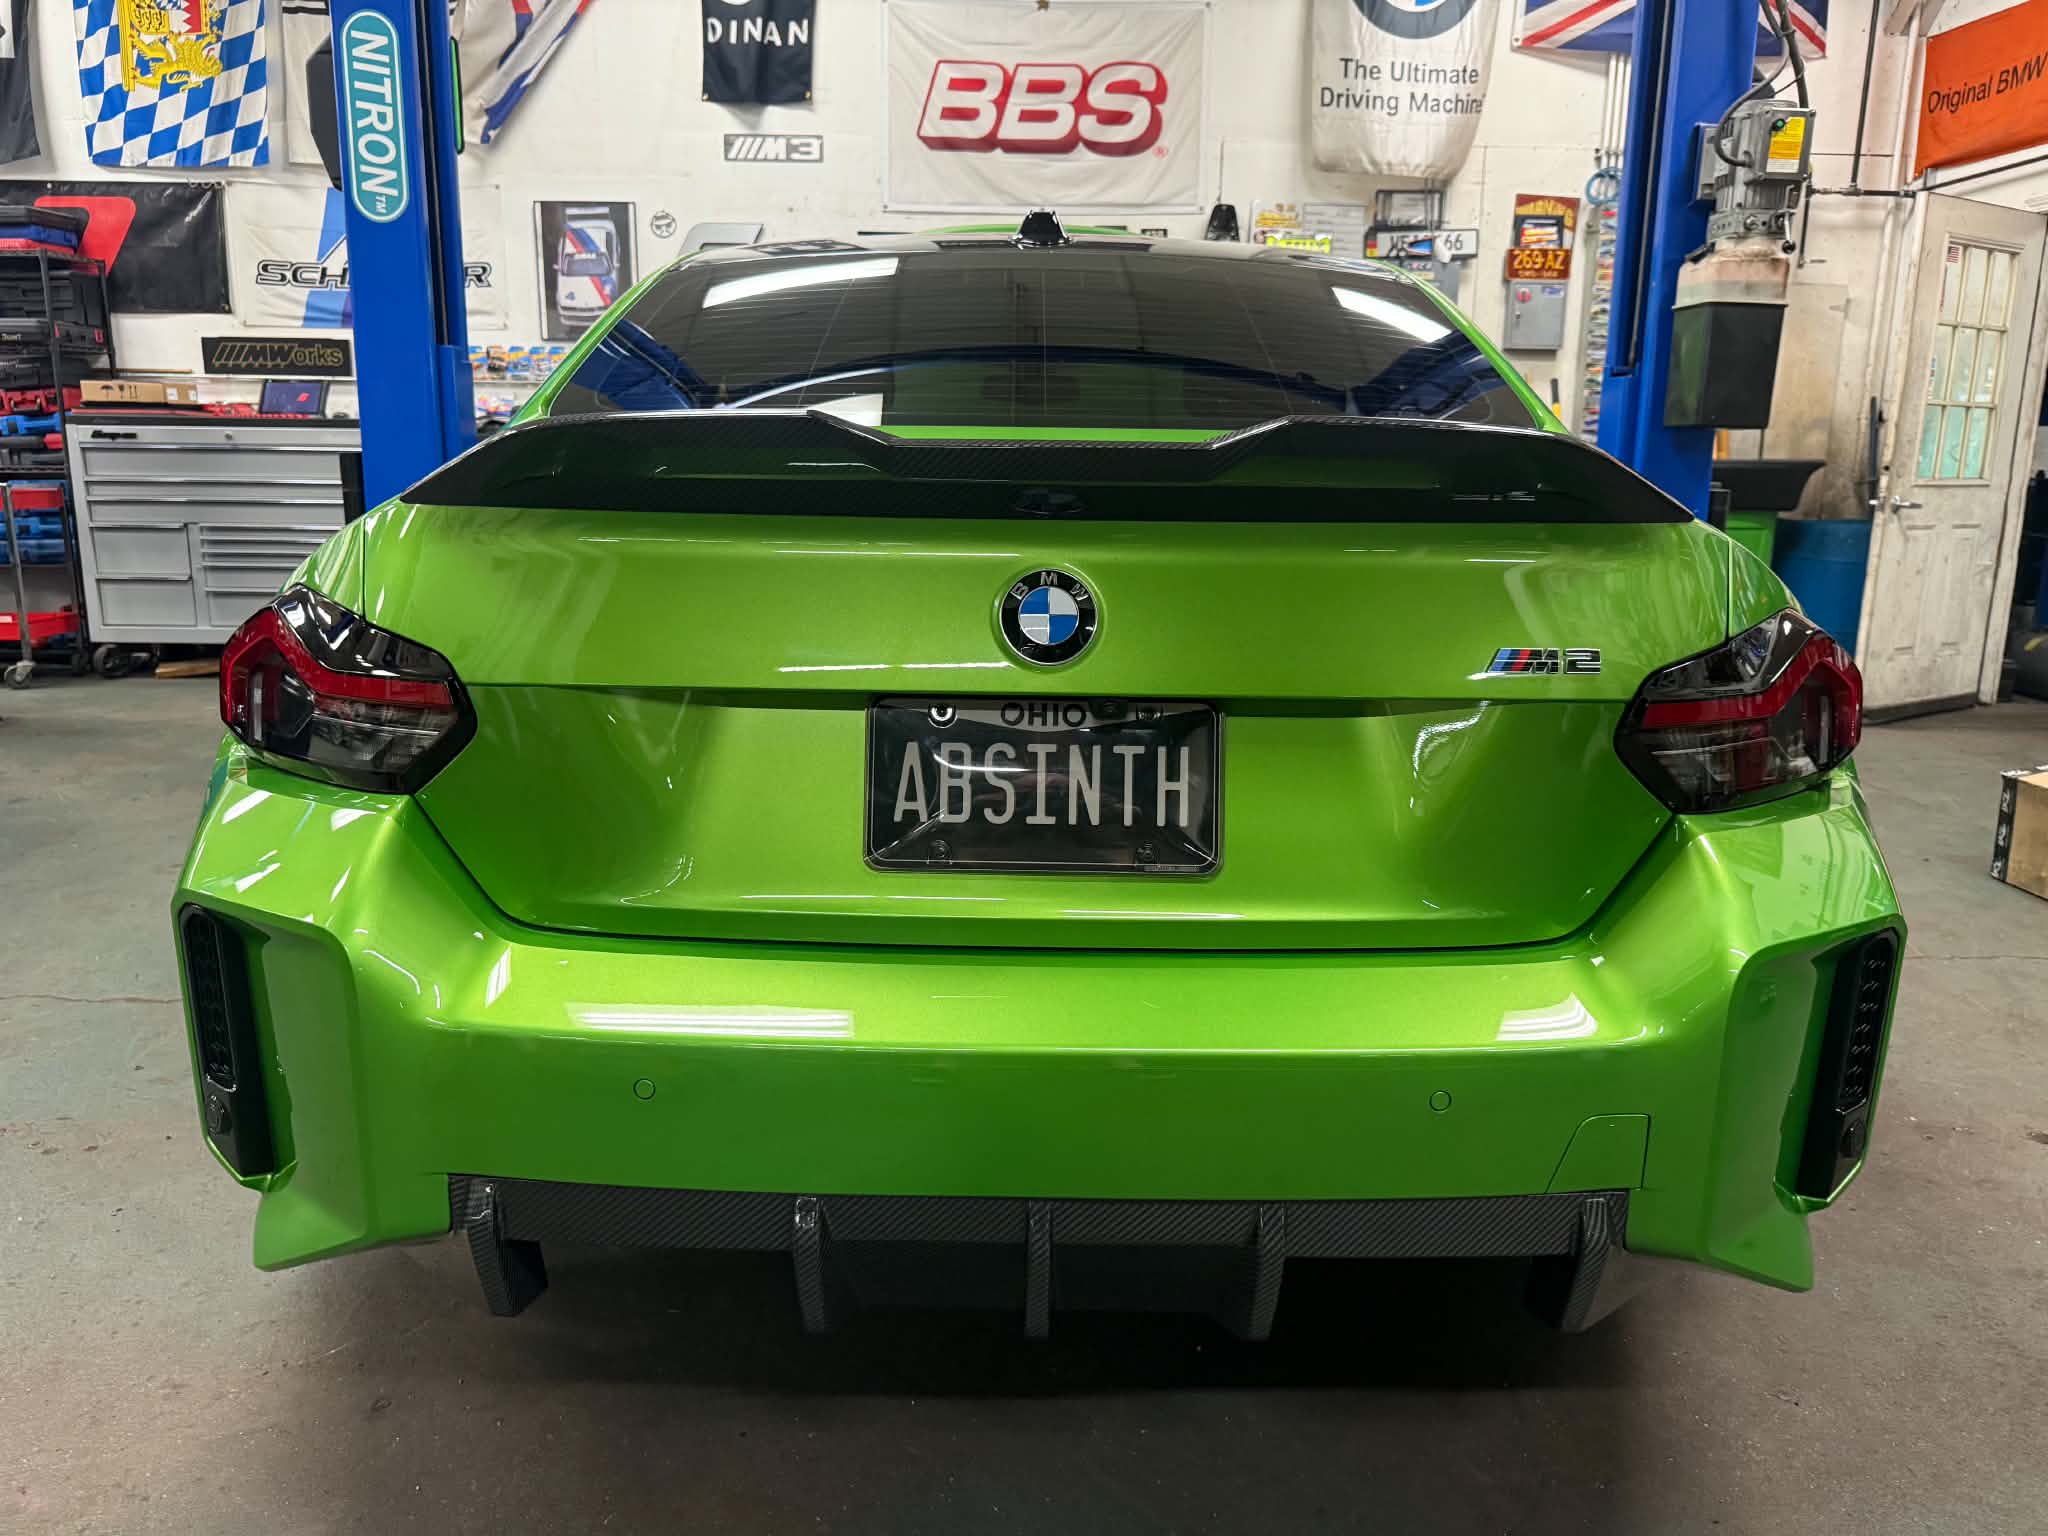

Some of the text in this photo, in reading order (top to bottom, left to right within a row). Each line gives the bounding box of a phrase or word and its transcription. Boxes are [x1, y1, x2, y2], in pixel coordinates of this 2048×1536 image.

[707, 17, 809, 47] DINAN
[1339, 58, 1480, 85] The Ultimate
[1928, 50, 2048, 115] Original BMW
[917, 60, 1168, 157] BBS
[1320, 87, 1400, 117] Driving
[1009, 571, 1089, 600] BMW
[1000, 702, 1088, 728] OHIO
[893, 741, 1190, 828] ABSINTH
